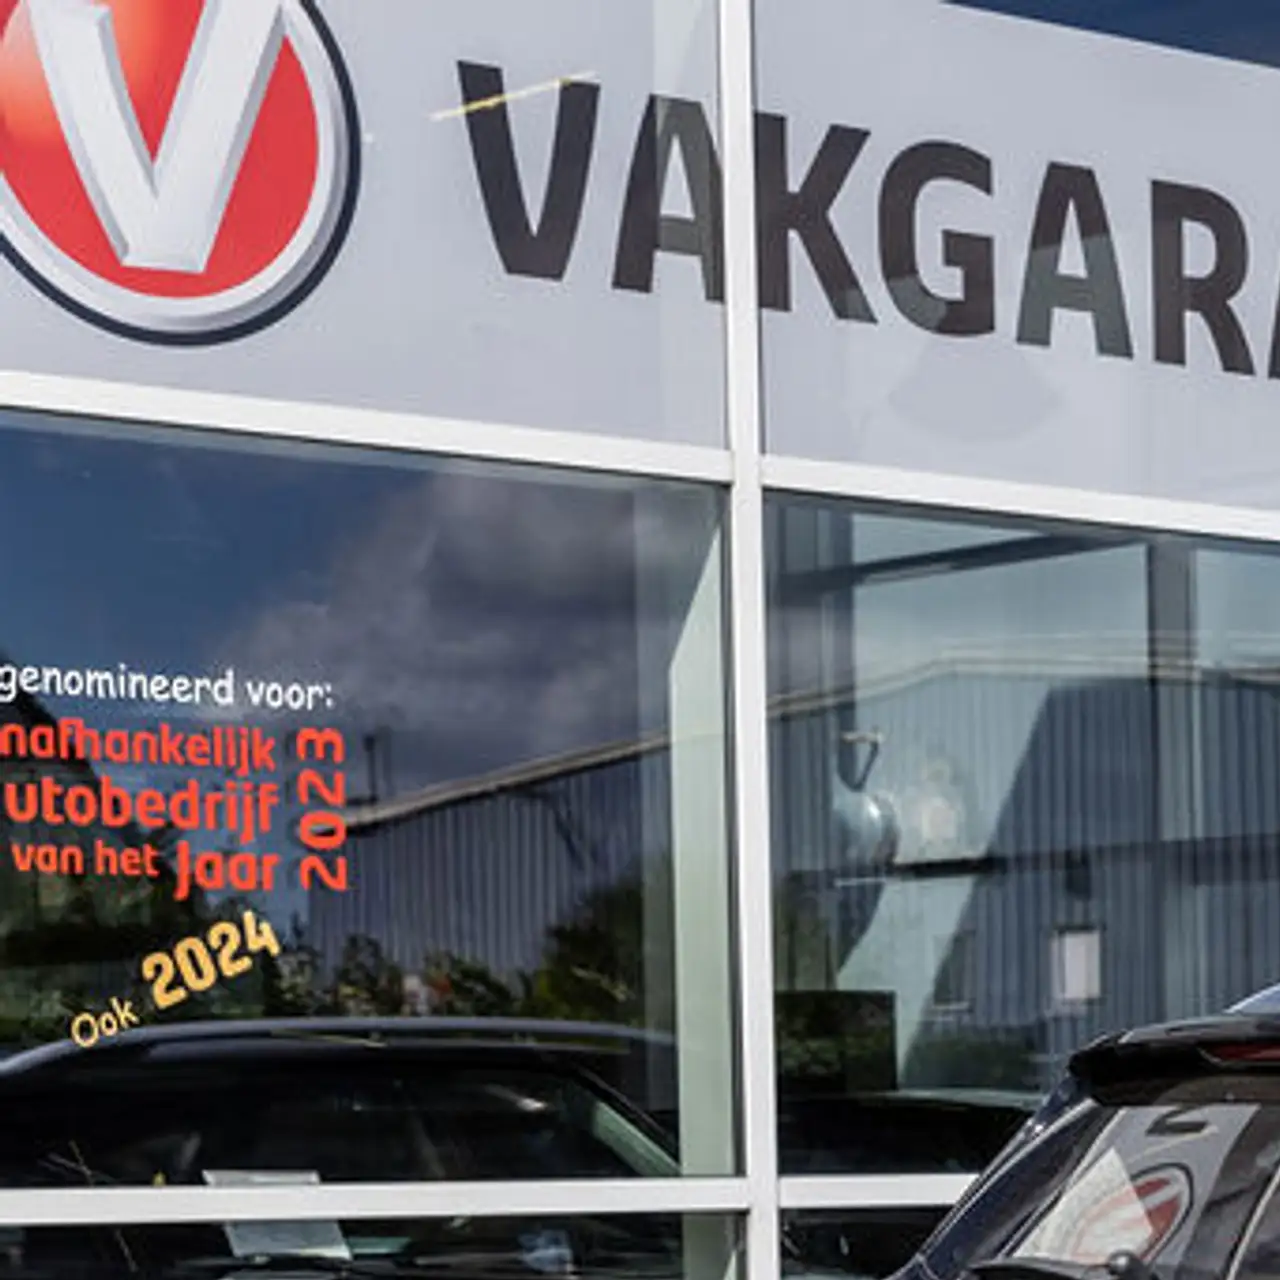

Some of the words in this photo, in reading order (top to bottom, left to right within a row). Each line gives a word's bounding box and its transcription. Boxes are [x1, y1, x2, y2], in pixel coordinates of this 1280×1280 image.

[0, 664, 235, 705] genomineerd
[246, 681, 333, 710] voor:
[296, 727, 348, 892] 2023
[11, 843, 84, 874] van
[95, 839, 160, 877] het
[70, 998, 140, 1049] Ook
[141, 909, 282, 1011] 2024
